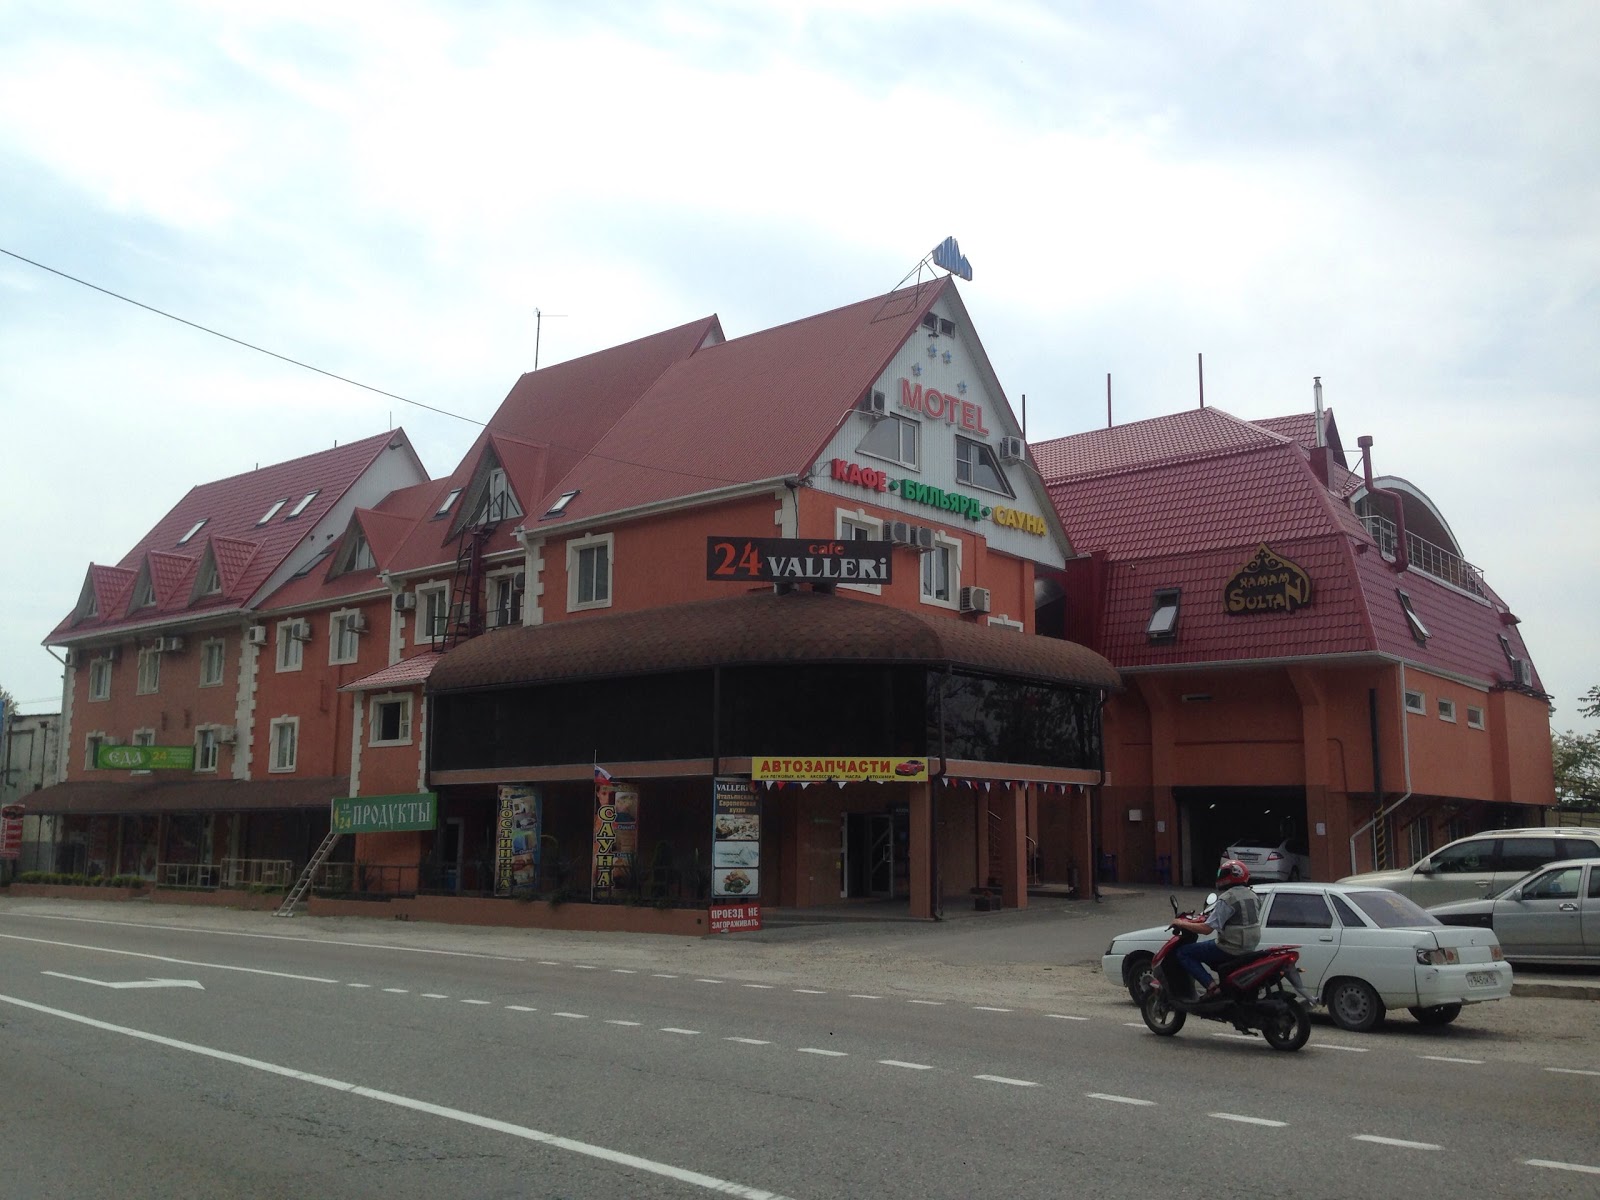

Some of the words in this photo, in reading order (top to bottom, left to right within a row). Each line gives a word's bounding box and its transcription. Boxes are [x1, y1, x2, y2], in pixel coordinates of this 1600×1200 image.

[901, 377, 989, 438] MOTEL
[831, 458, 887, 493] КАФЕ
[901, 479, 981, 521] БИЛЬЯРД
[993, 506, 1047, 536] САУНА
[714, 541, 763, 577] 24
[809, 542, 845, 556] cafe
[767, 557, 888, 580] VALLERi
[152, 751, 168, 761] 24
[760, 760, 891, 773] АВТОЗАПЧАСТИ
[353, 802, 431, 829] ПРОДУКТЫ
[597, 806, 616, 887] САУНА
[711, 908, 744, 919] ПРОЕЗД
[748, 907, 759, 917] НЕ
[711, 919, 759, 929] ЗАГОРАЖИВАТЬ
